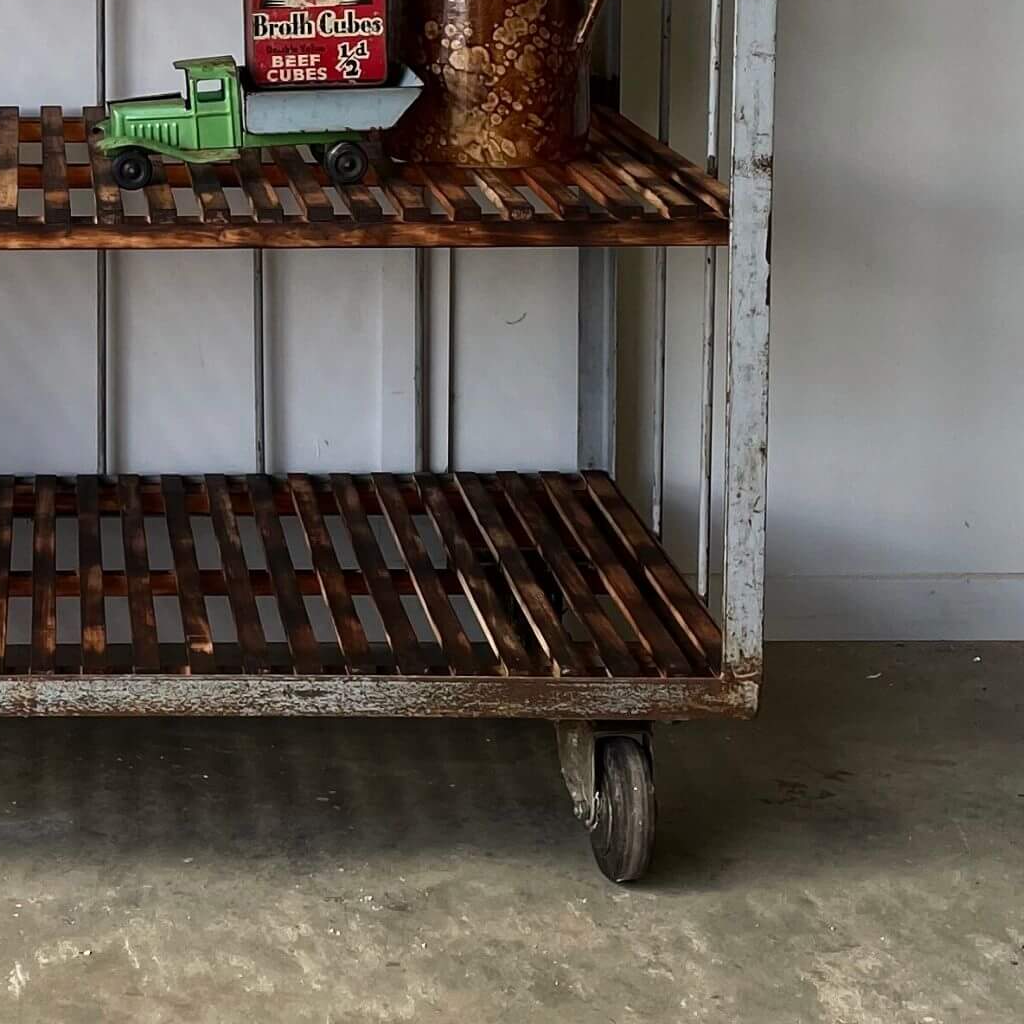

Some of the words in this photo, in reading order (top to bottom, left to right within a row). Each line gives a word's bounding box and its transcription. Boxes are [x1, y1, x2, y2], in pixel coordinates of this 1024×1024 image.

[252, 11, 315, 39] Broth
[318, 9, 383, 37] Cubes
[271, 54, 321, 68] BEEF
[266, 67, 328, 82] CUBES
